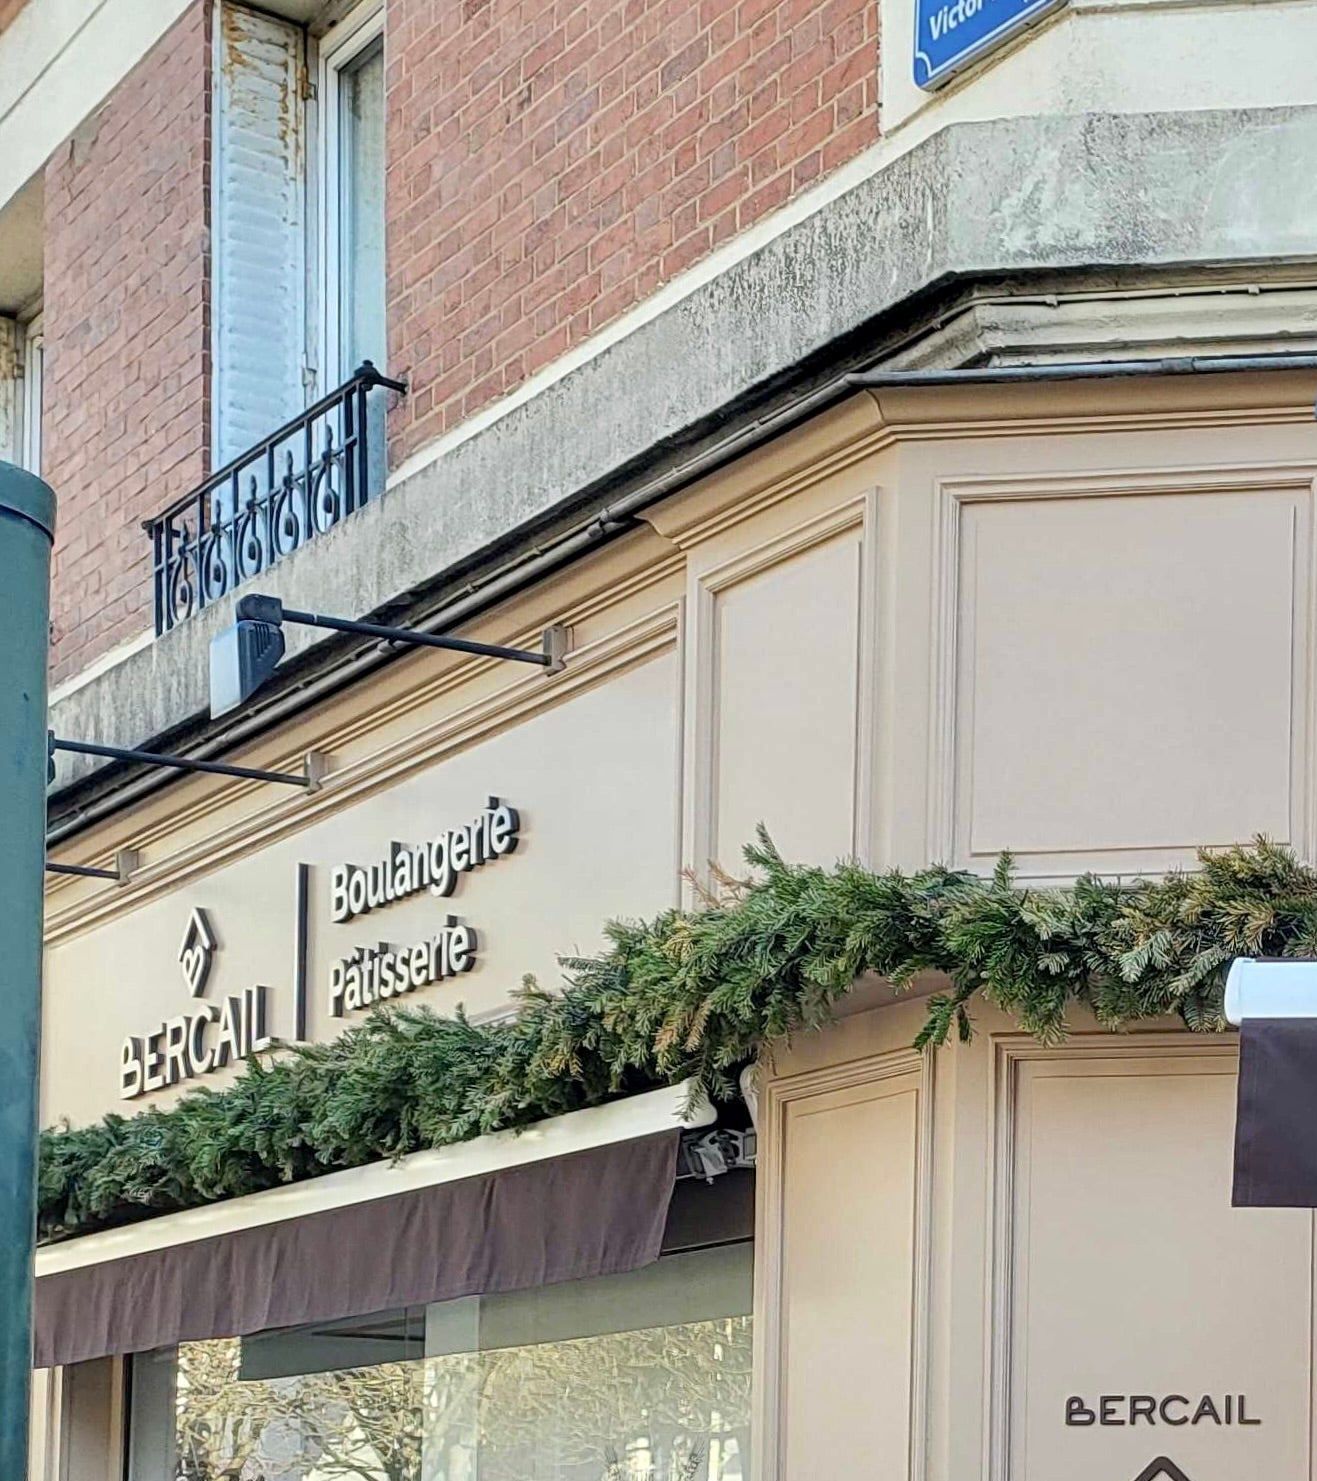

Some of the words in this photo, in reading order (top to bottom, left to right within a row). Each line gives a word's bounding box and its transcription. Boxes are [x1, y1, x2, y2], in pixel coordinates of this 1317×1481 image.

[331, 796, 520, 923] Boulangerie
[328, 915, 478, 1017] Pâtisserie
[119, 984, 272, 1099] BERCAIL
[1065, 1394, 1262, 1426] BERCAIL
